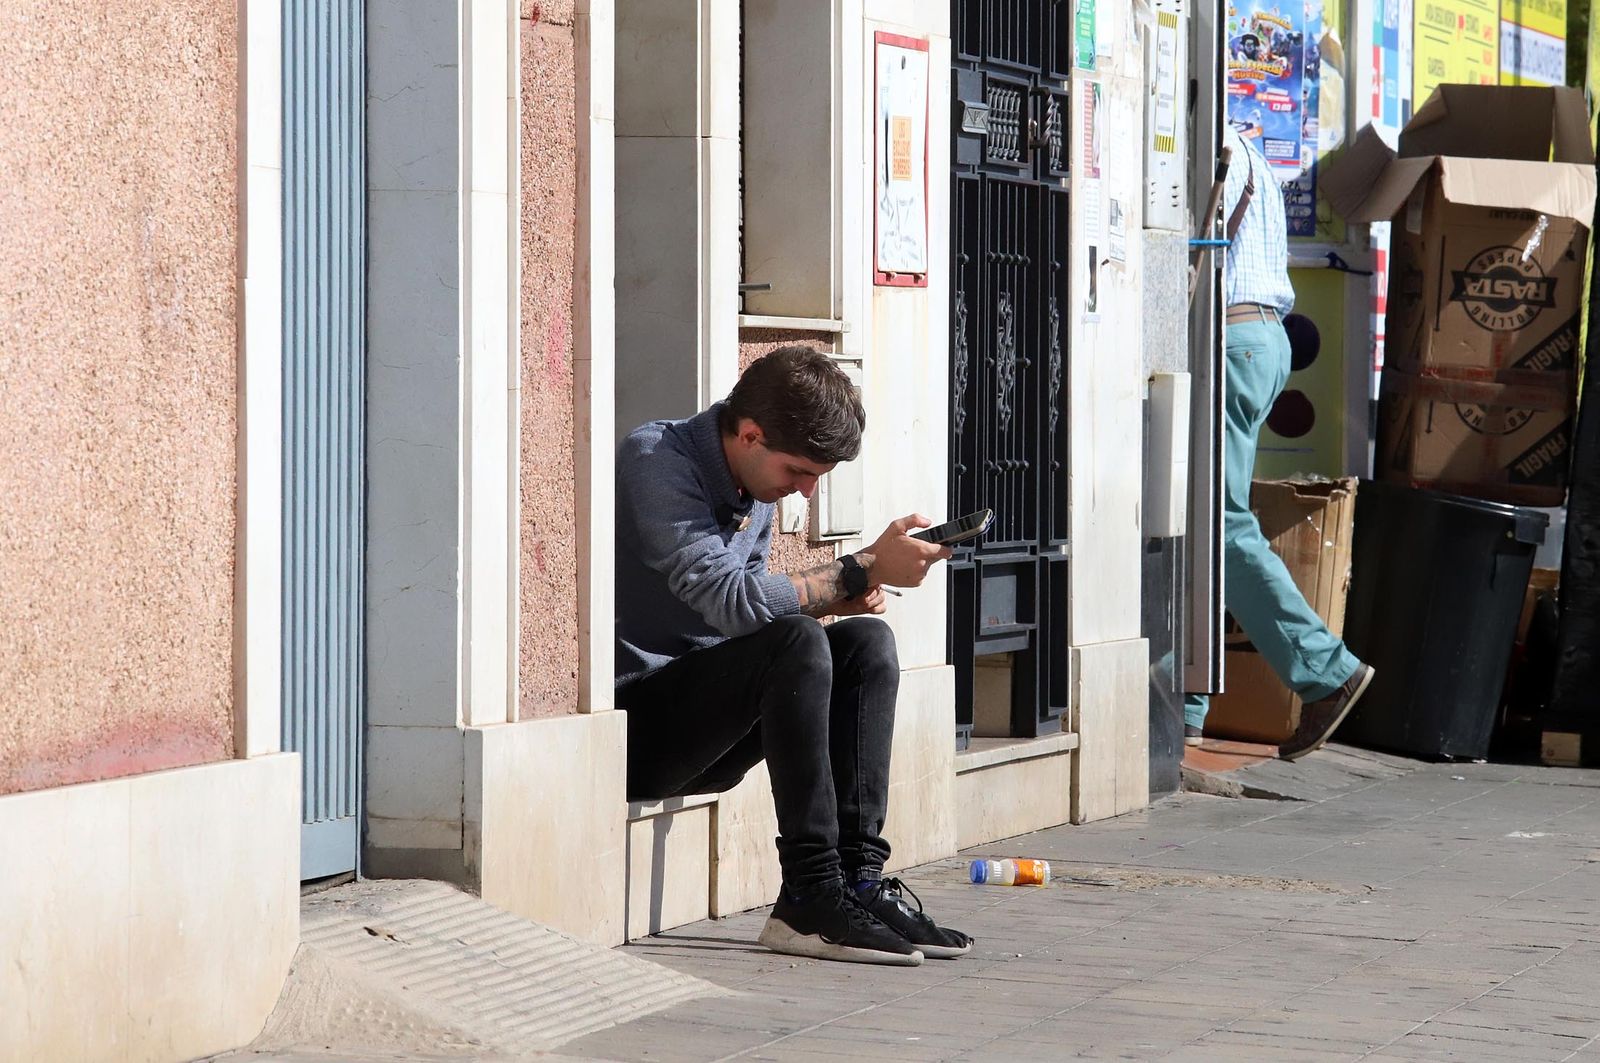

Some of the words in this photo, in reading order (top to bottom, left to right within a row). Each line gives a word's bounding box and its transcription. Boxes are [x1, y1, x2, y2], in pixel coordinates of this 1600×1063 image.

[1464, 278, 1547, 301] RASTA
[1471, 305, 1535, 328] ROLLING
[1462, 409, 1530, 431] RONG
